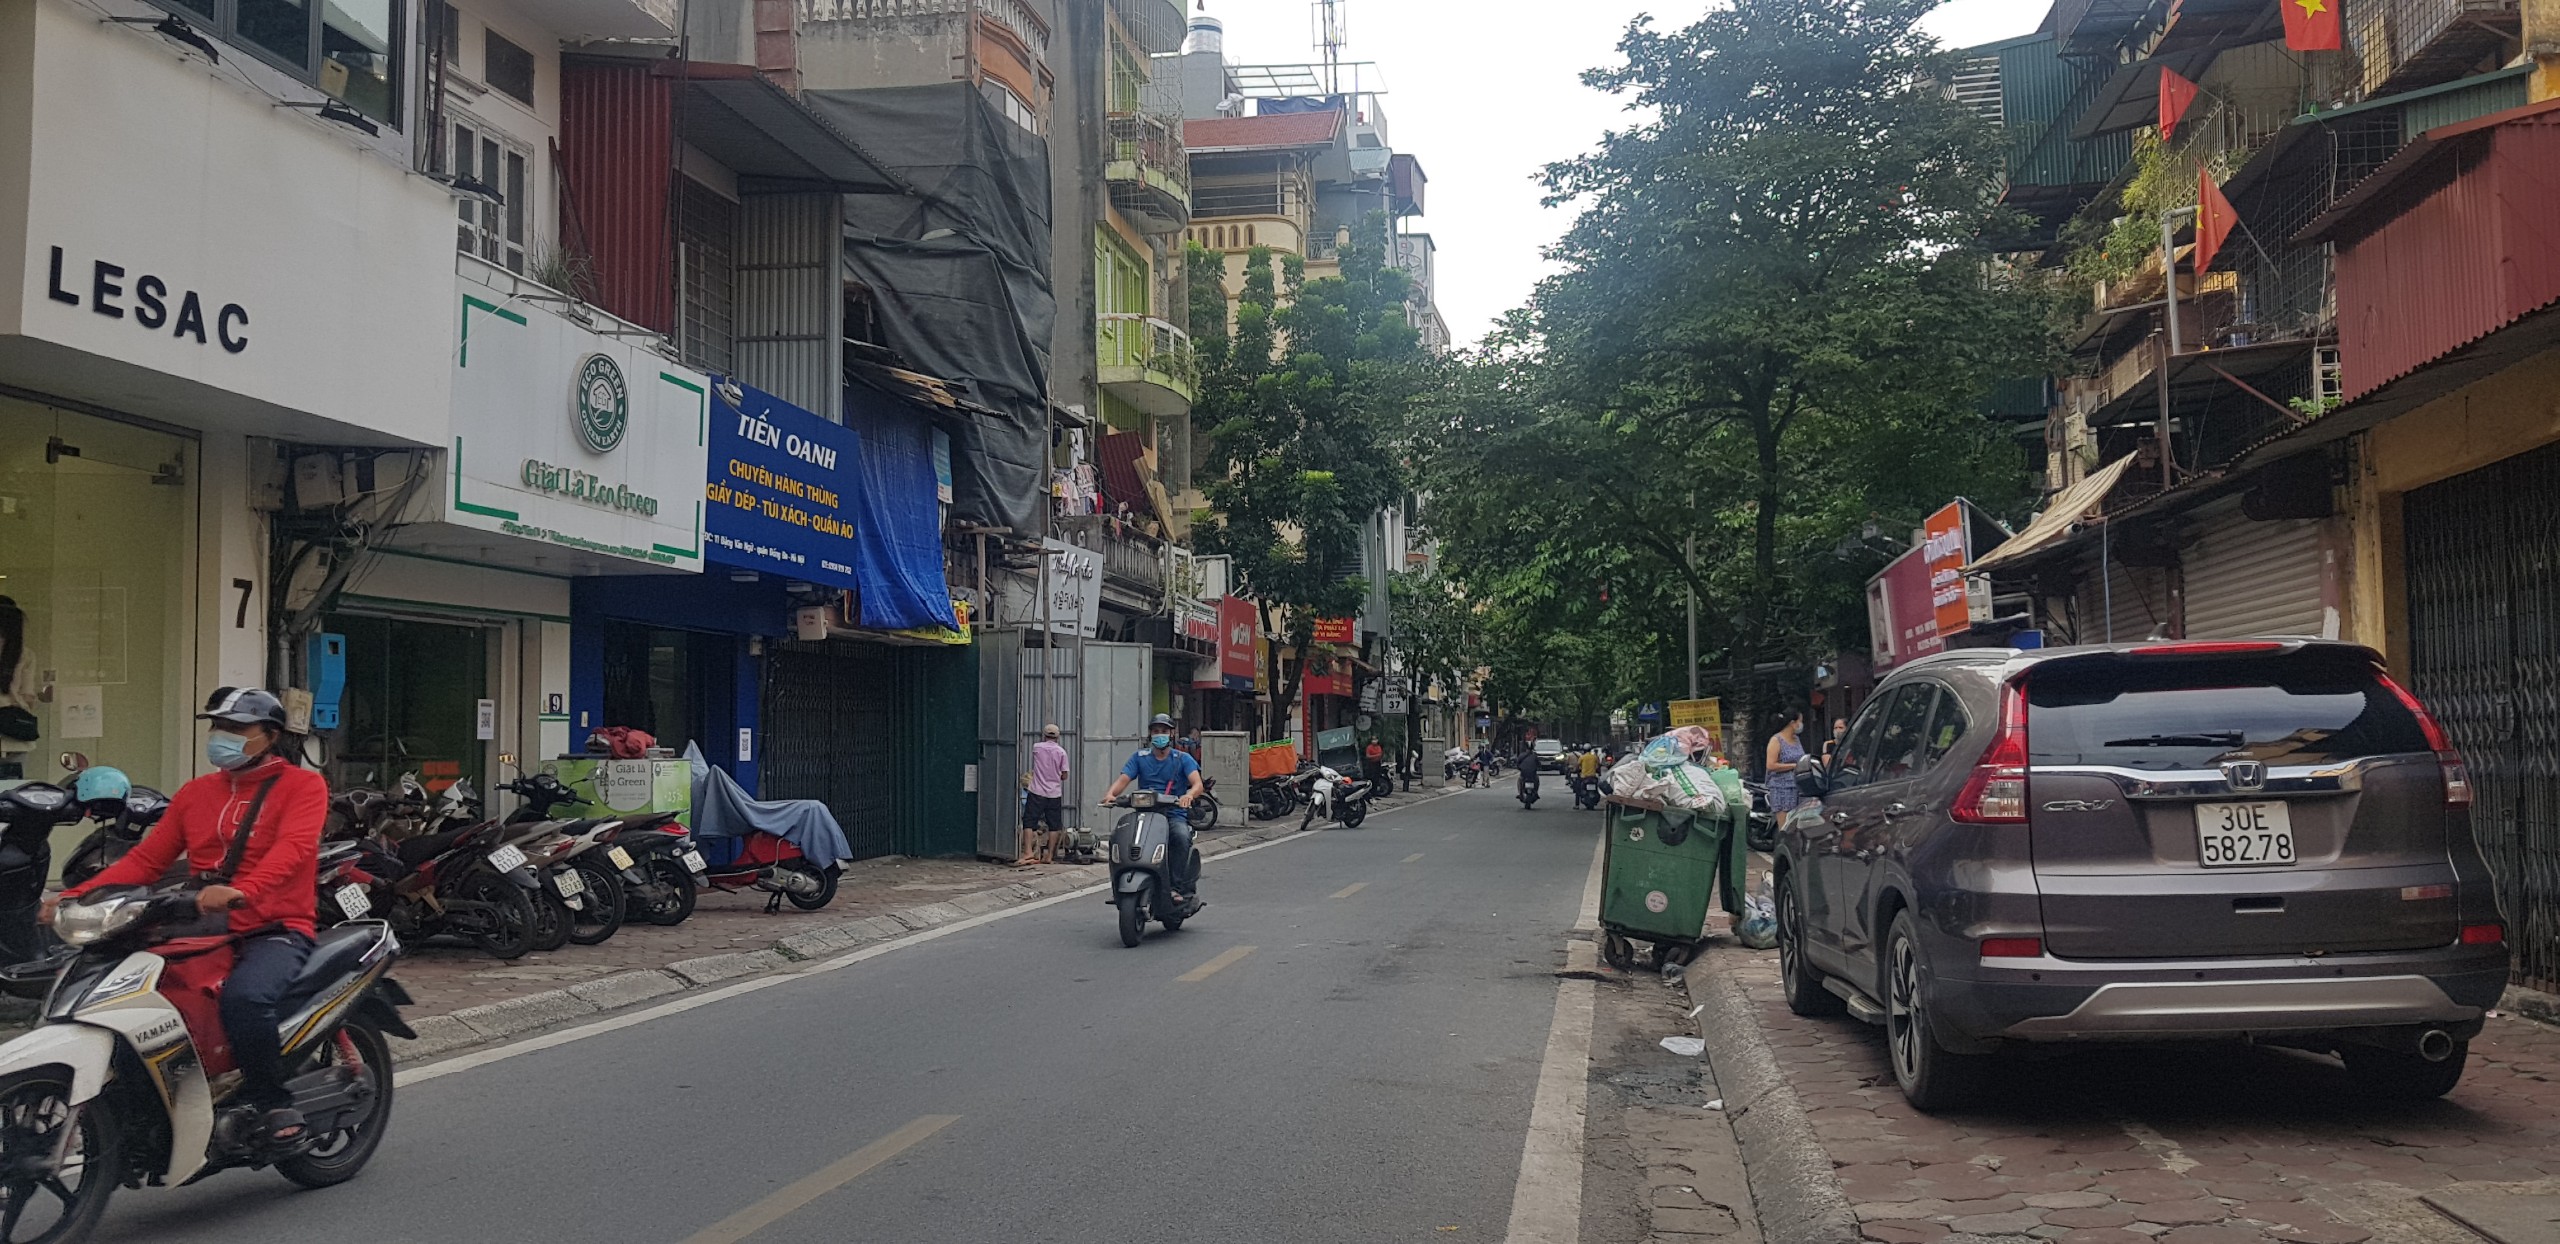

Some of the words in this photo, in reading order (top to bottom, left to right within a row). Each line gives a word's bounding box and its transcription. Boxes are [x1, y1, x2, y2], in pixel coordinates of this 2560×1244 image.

[49, 245, 249, 354] LESAC
[581, 363, 597, 391] ECO
[598, 360, 624, 399] GREEN
[582, 410, 601, 444] GREEN
[602, 420, 622, 446] EARTH
[738, 408, 782, 450] TIẾN
[786, 434, 838, 471] OANH
[584, 474, 615, 506] Eco
[614, 484, 658, 517] Green
[729, 458, 773, 488] CHUYÊN
[775, 472, 804, 498] HÀNG
[806, 484, 839, 509] THÙNG
[735, 488, 756, 511] DÉP
[762, 497, 779, 518] TÚI
[780, 503, 808, 527] XÁCH
[840, 519, 854, 540] ÁO
[233, 578, 253, 628] 7
[552, 695, 561, 711] 9
[1389, 701, 1400, 709] 37
[616, 764, 636, 774] Giặt
[638, 764, 646, 773] là
[617, 777, 646, 786] Green
[2042, 799, 2115, 812] CR-V
[2218, 804, 2270, 832] 30E
[2203, 833, 2291, 863] 582.78
[135, 1018, 180, 1043] YAMAHA
